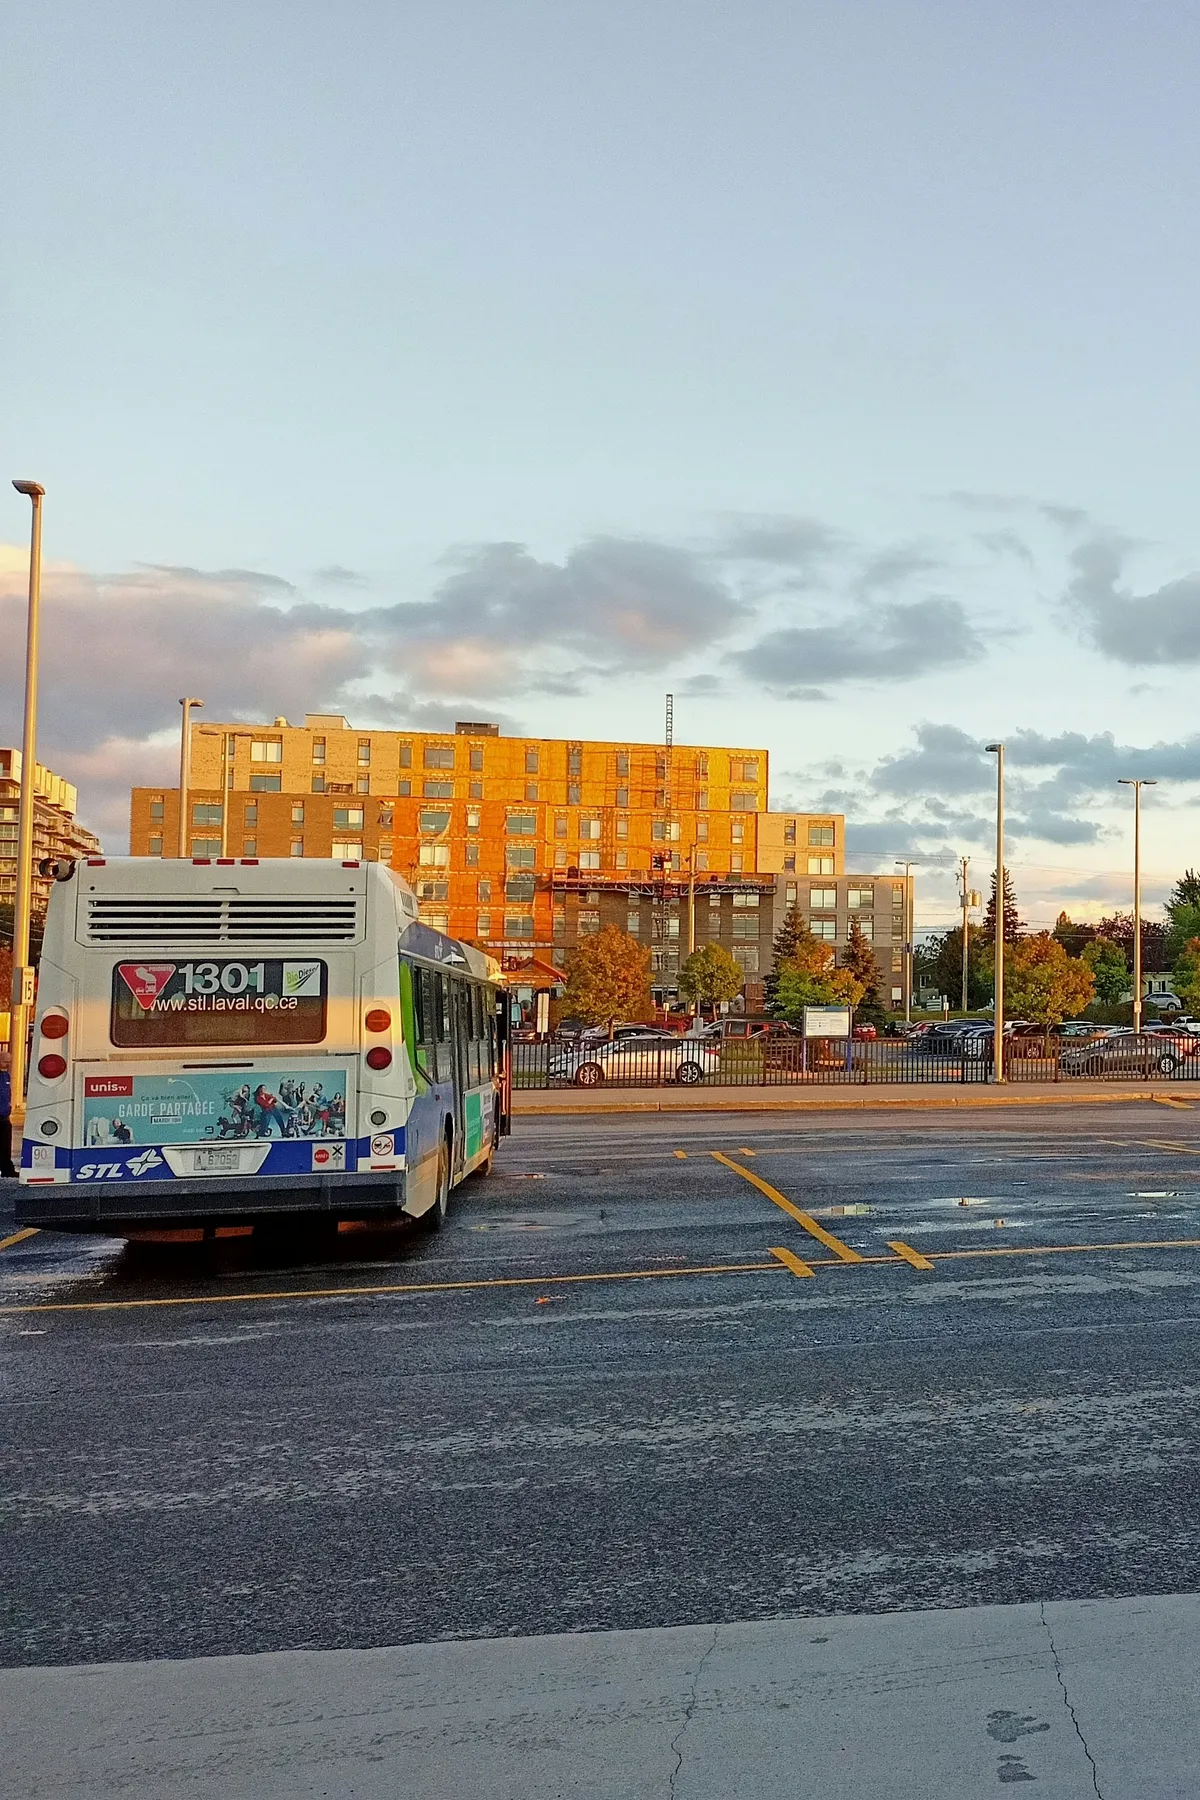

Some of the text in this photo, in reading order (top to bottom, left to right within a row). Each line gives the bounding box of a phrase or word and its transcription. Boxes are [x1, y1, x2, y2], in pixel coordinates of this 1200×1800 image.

[178, 962, 265, 994] 1301
[24, 981, 33, 1001] 15
[150, 995, 297, 1012] ww.stl.laval.qc.ca
[118, 1100, 215, 1118] GARDE PARTAGÉE
[33, 1148, 48, 1160] 90
[76, 1163, 123, 1179] STL
